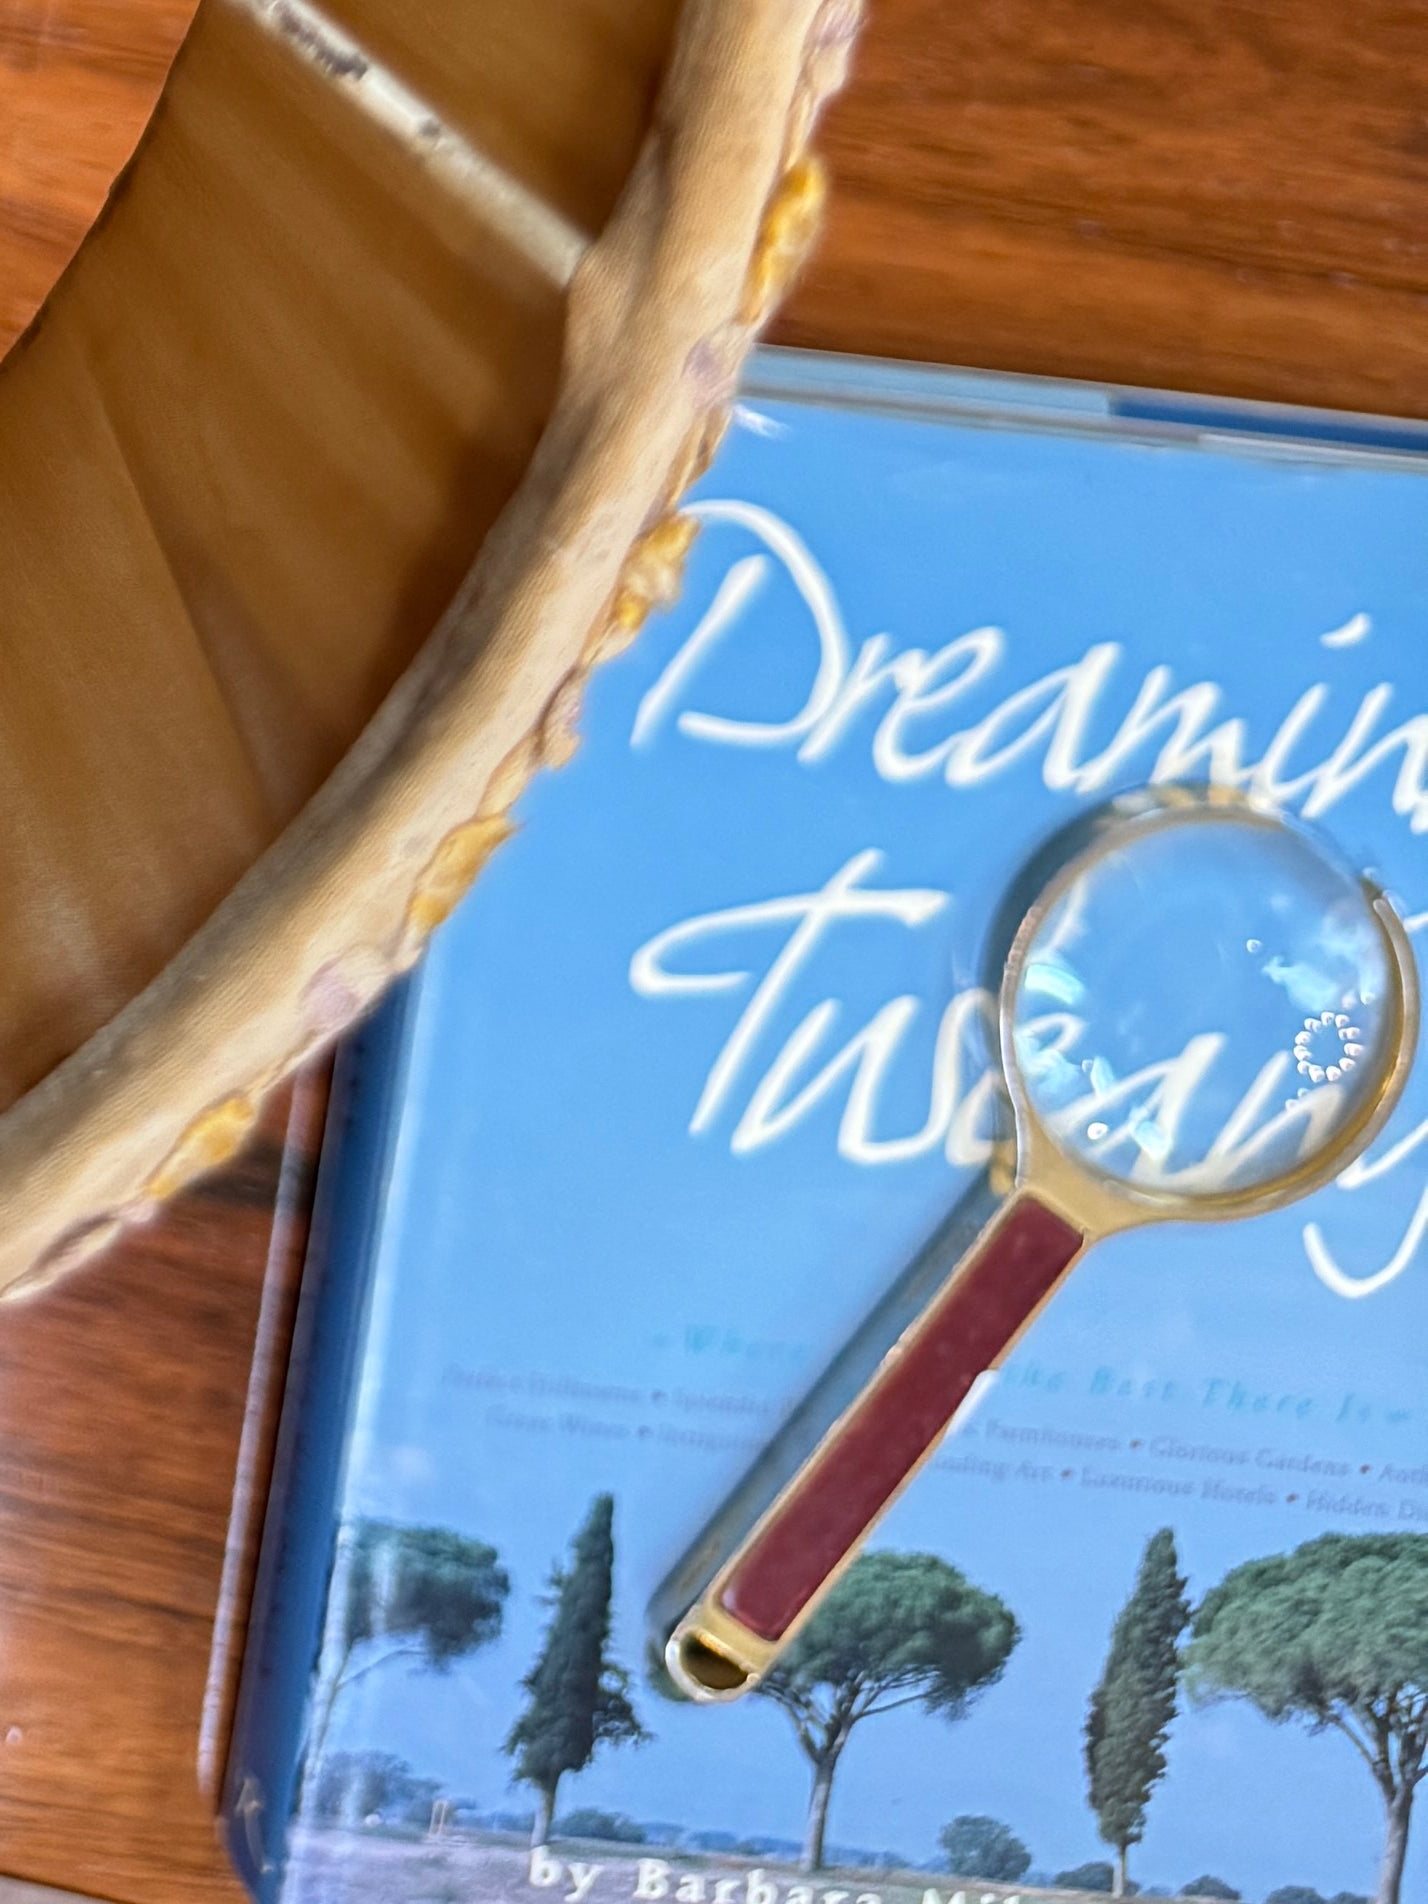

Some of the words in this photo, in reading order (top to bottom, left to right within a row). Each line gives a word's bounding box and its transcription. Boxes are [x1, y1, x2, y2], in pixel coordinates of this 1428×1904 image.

[629, 498, 1428, 836] Dreamin
[1149, 1439, 1249, 1466] Glorious
[1255, 1447, 1351, 1476] Gardens
[1306, 1489, 1391, 1518] Hidden
[529, 1845, 605, 1903] by
